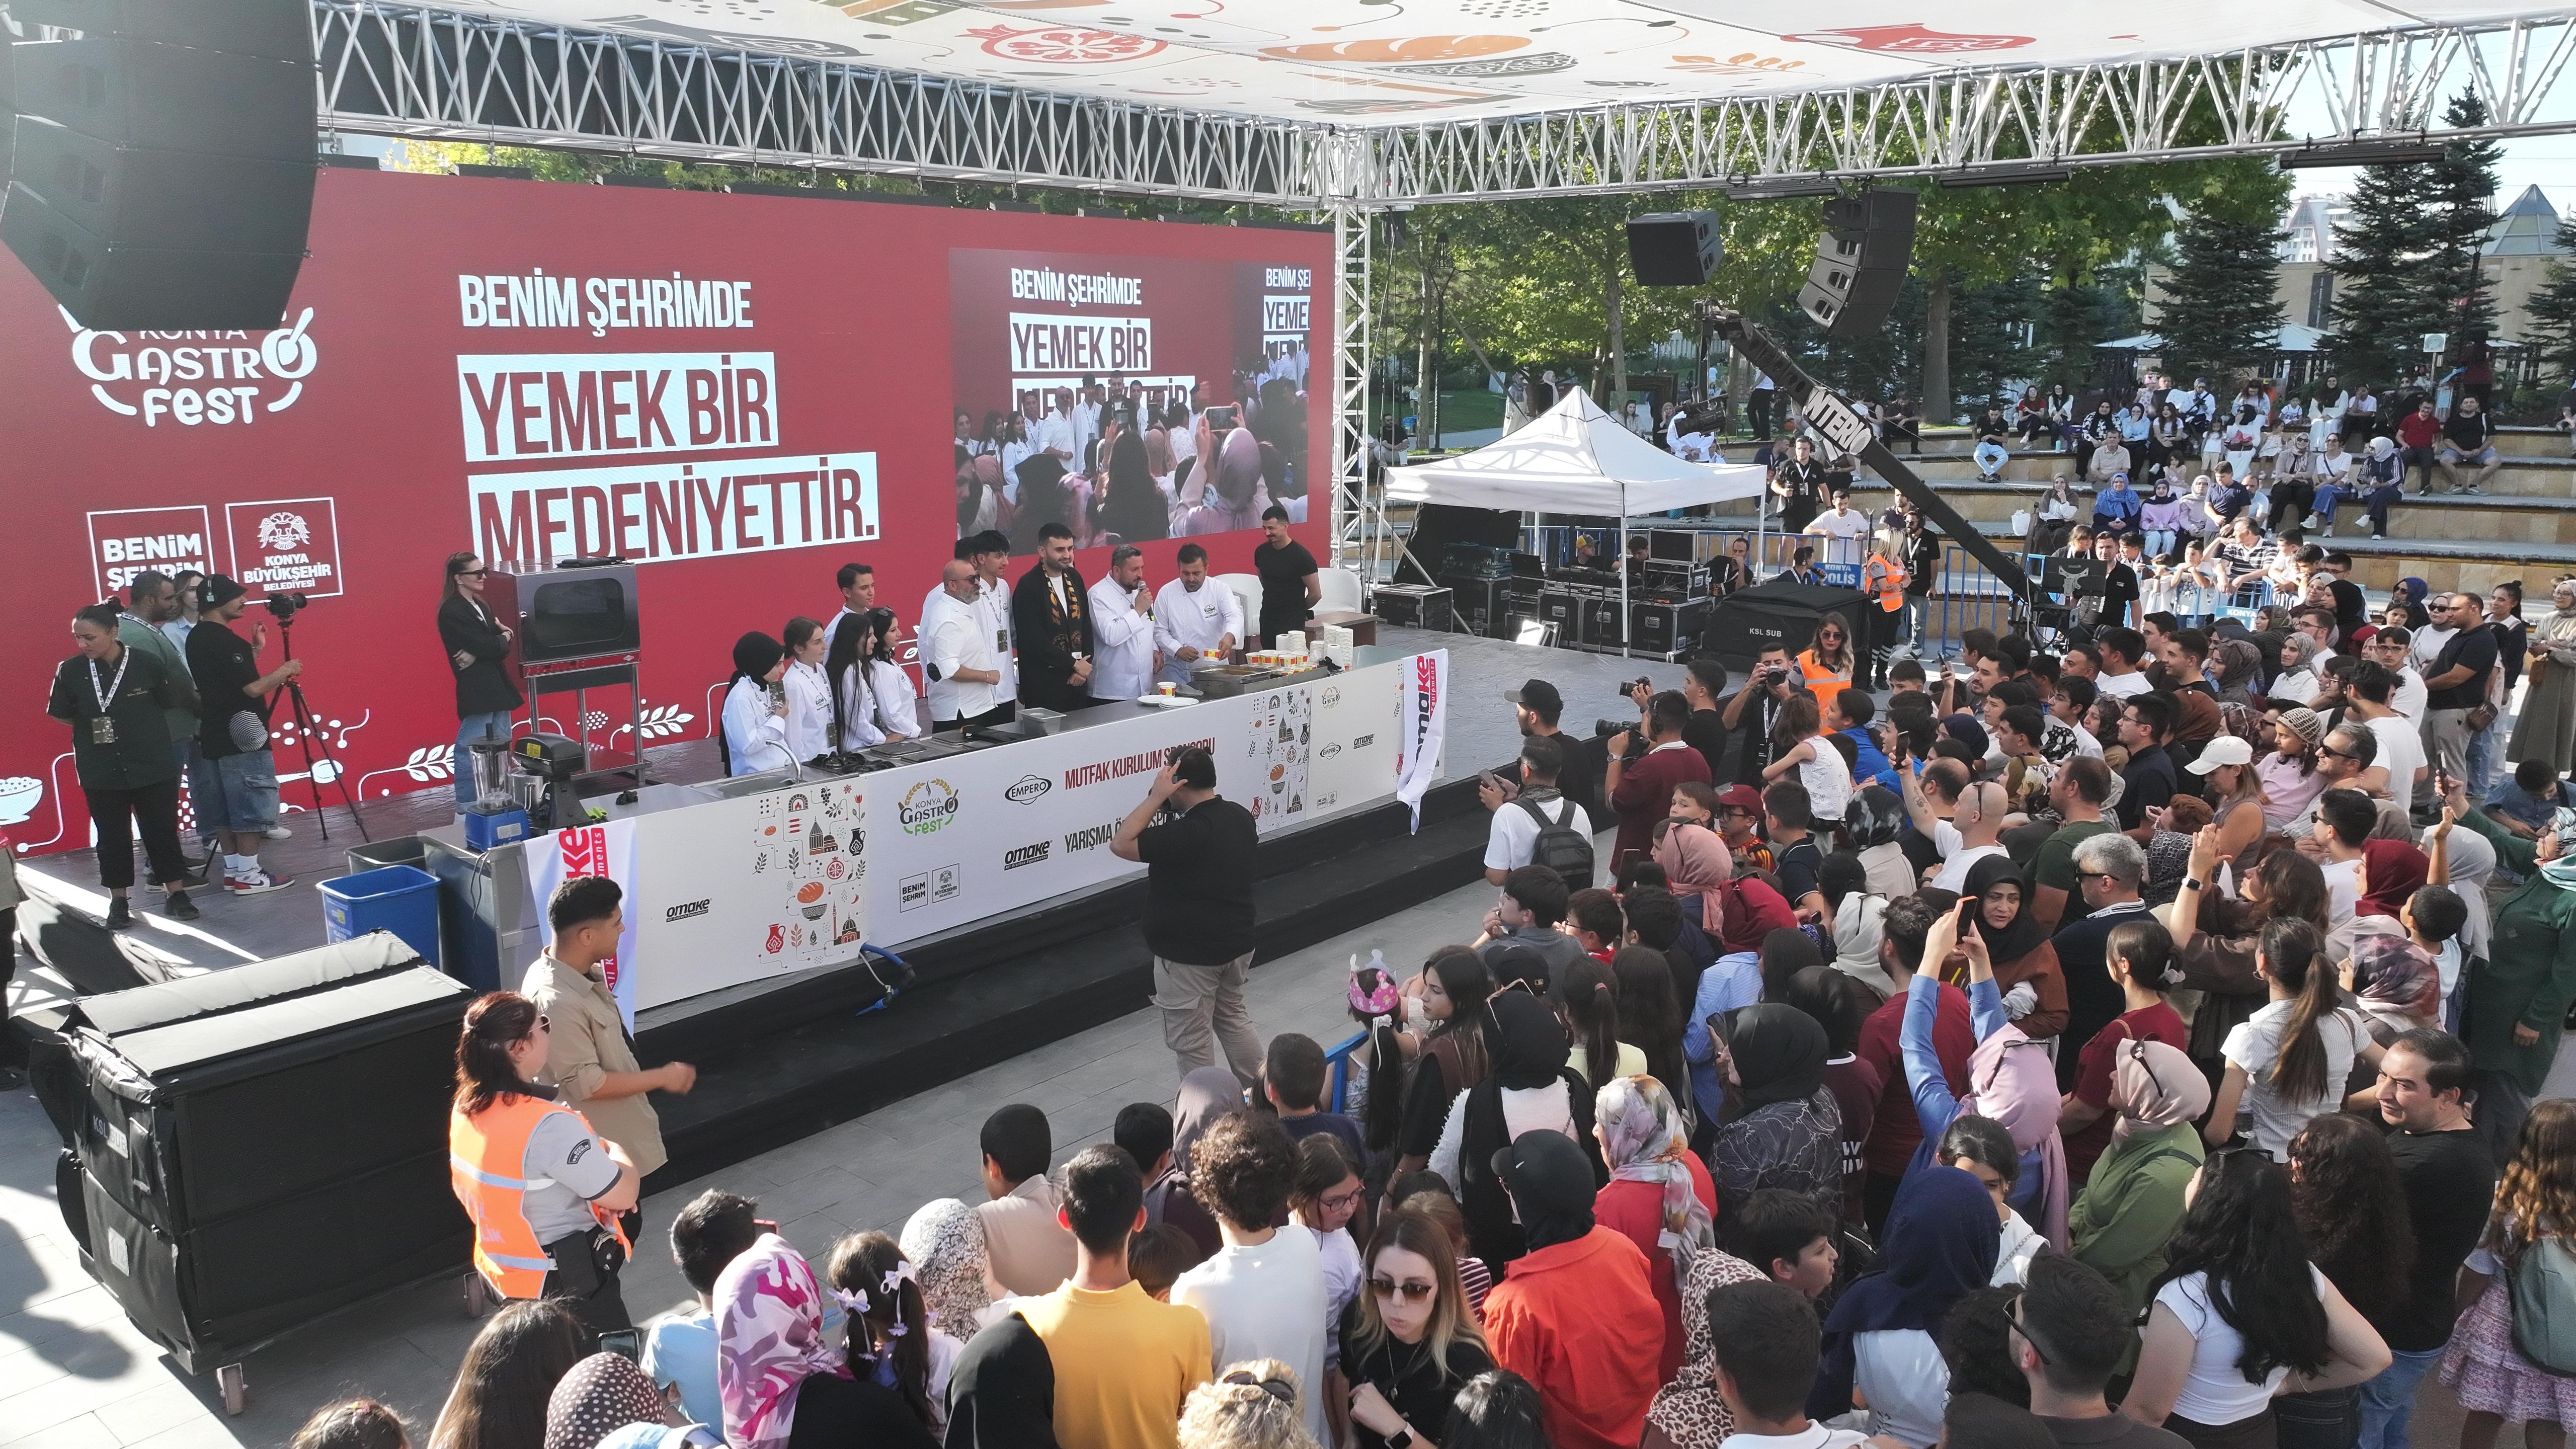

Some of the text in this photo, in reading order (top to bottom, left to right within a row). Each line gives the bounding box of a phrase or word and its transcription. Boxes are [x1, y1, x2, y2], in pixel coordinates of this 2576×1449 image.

[1011, 267, 1142, 307] BENİM ŞEHRİMDE
[1266, 266, 1311, 290] BENİM ŞE
[459, 268, 753, 337] BENİM ŞEHRİMDE
[1265, 301, 1310, 330] YEME
[1012, 319, 1147, 369] YEMEK BİR
[72, 328, 318, 386] GASTRO
[463, 354, 771, 455] YEMEK BİR
[102, 533, 202, 562] BENİM
[265, 553, 310, 567] KONYA
[244, 562, 332, 584] BÜYÜKŞEHİR
[263, 578, 315, 591] BELEDİYESİ
[1828, 572, 1855, 584] OLİS
[2227, 608, 2257, 618] KONYA
[1766, 629, 1782, 637] SUB
[1354, 734, 1374, 746] omake
[1065, 761, 1110, 790] MUTFAK
[1112, 750, 1162, 779] KURULUM
[1012, 781, 1046, 797] EMPERO
[900, 797, 958, 824] GASTRO
[916, 797, 941, 809] KONYA
[1065, 823, 1112, 853] YARIŞMA
[1005, 841, 1050, 864] omake
[902, 881, 925, 895] BENİM
[903, 891, 926, 904] ŞEHRİM
[667, 899, 710, 917] omake
[93, 1115, 108, 1140] KSL
